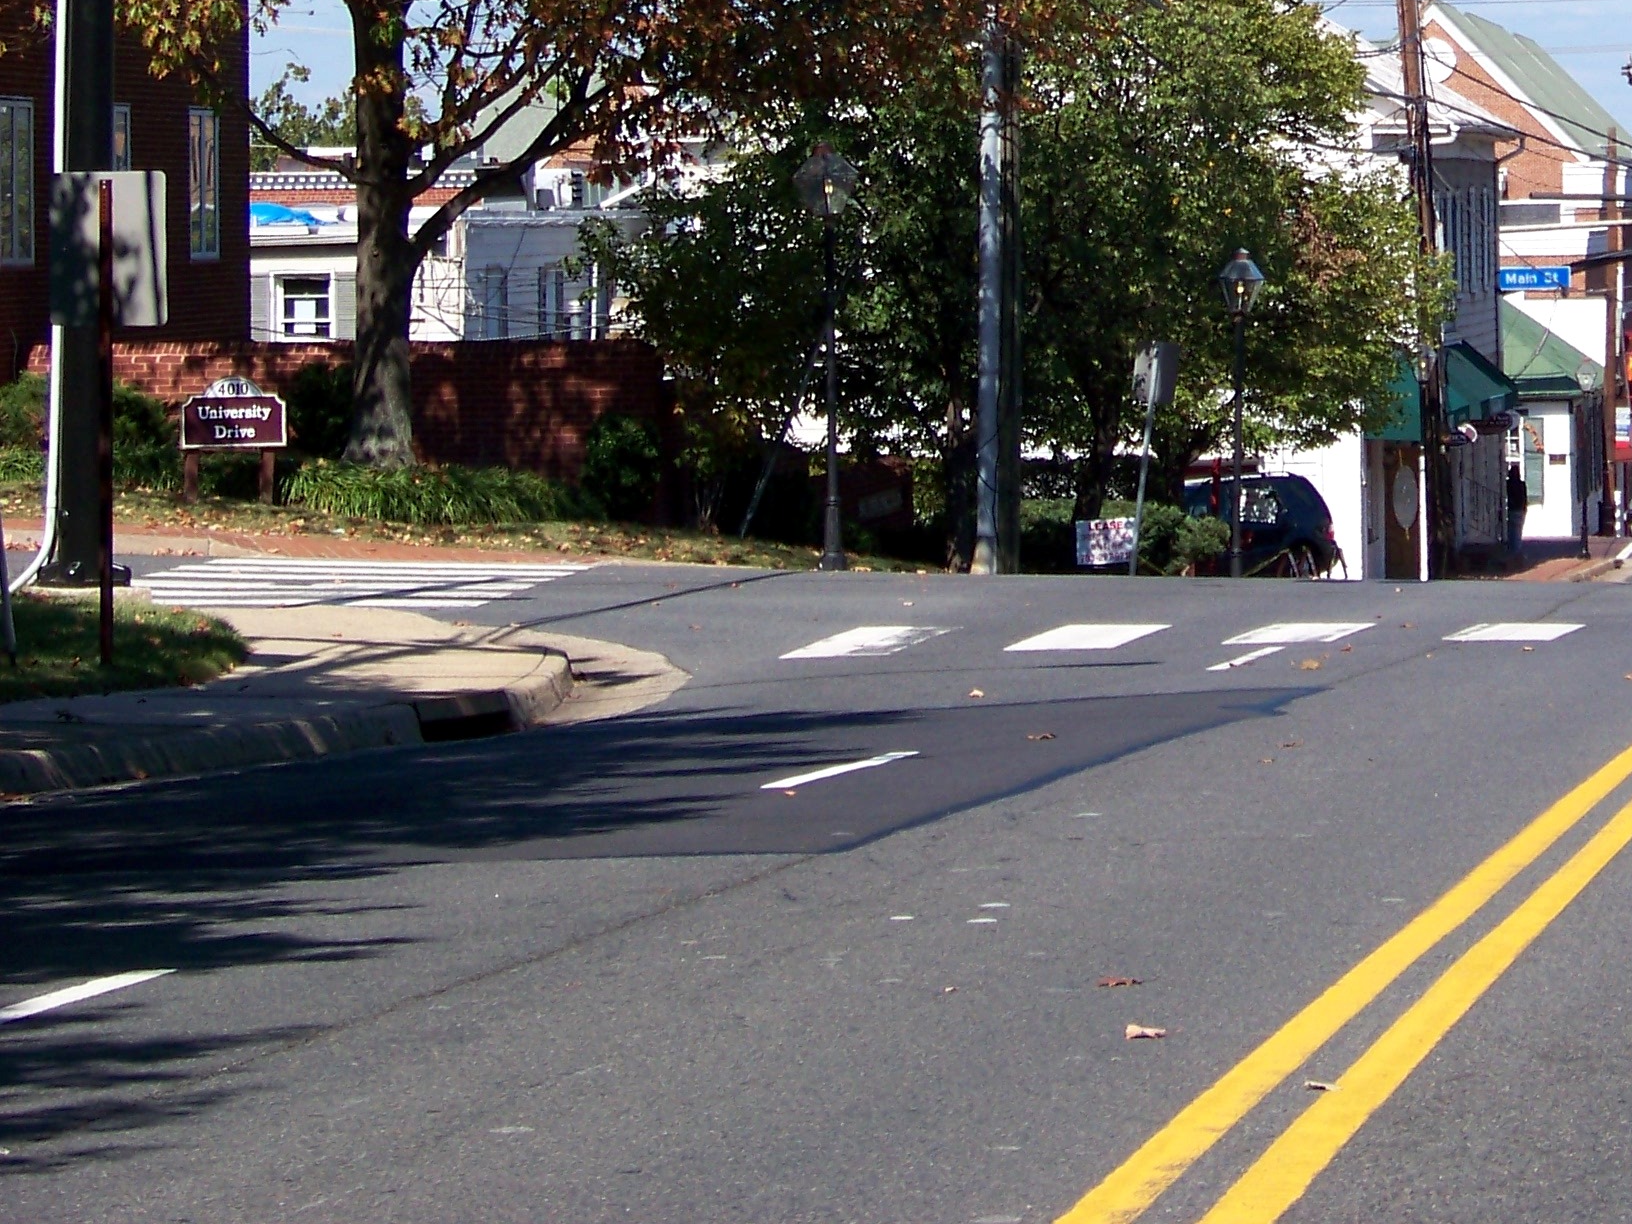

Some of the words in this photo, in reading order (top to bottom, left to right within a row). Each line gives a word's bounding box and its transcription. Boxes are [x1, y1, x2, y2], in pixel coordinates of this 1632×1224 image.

[1505, 273, 1538, 285] Main
[1544, 272, 1559, 283] St
[217, 383, 249, 395] 4010
[197, 405, 272, 421] University
[214, 424, 256, 439] Drive
[1088, 520, 1124, 532] LEASE
